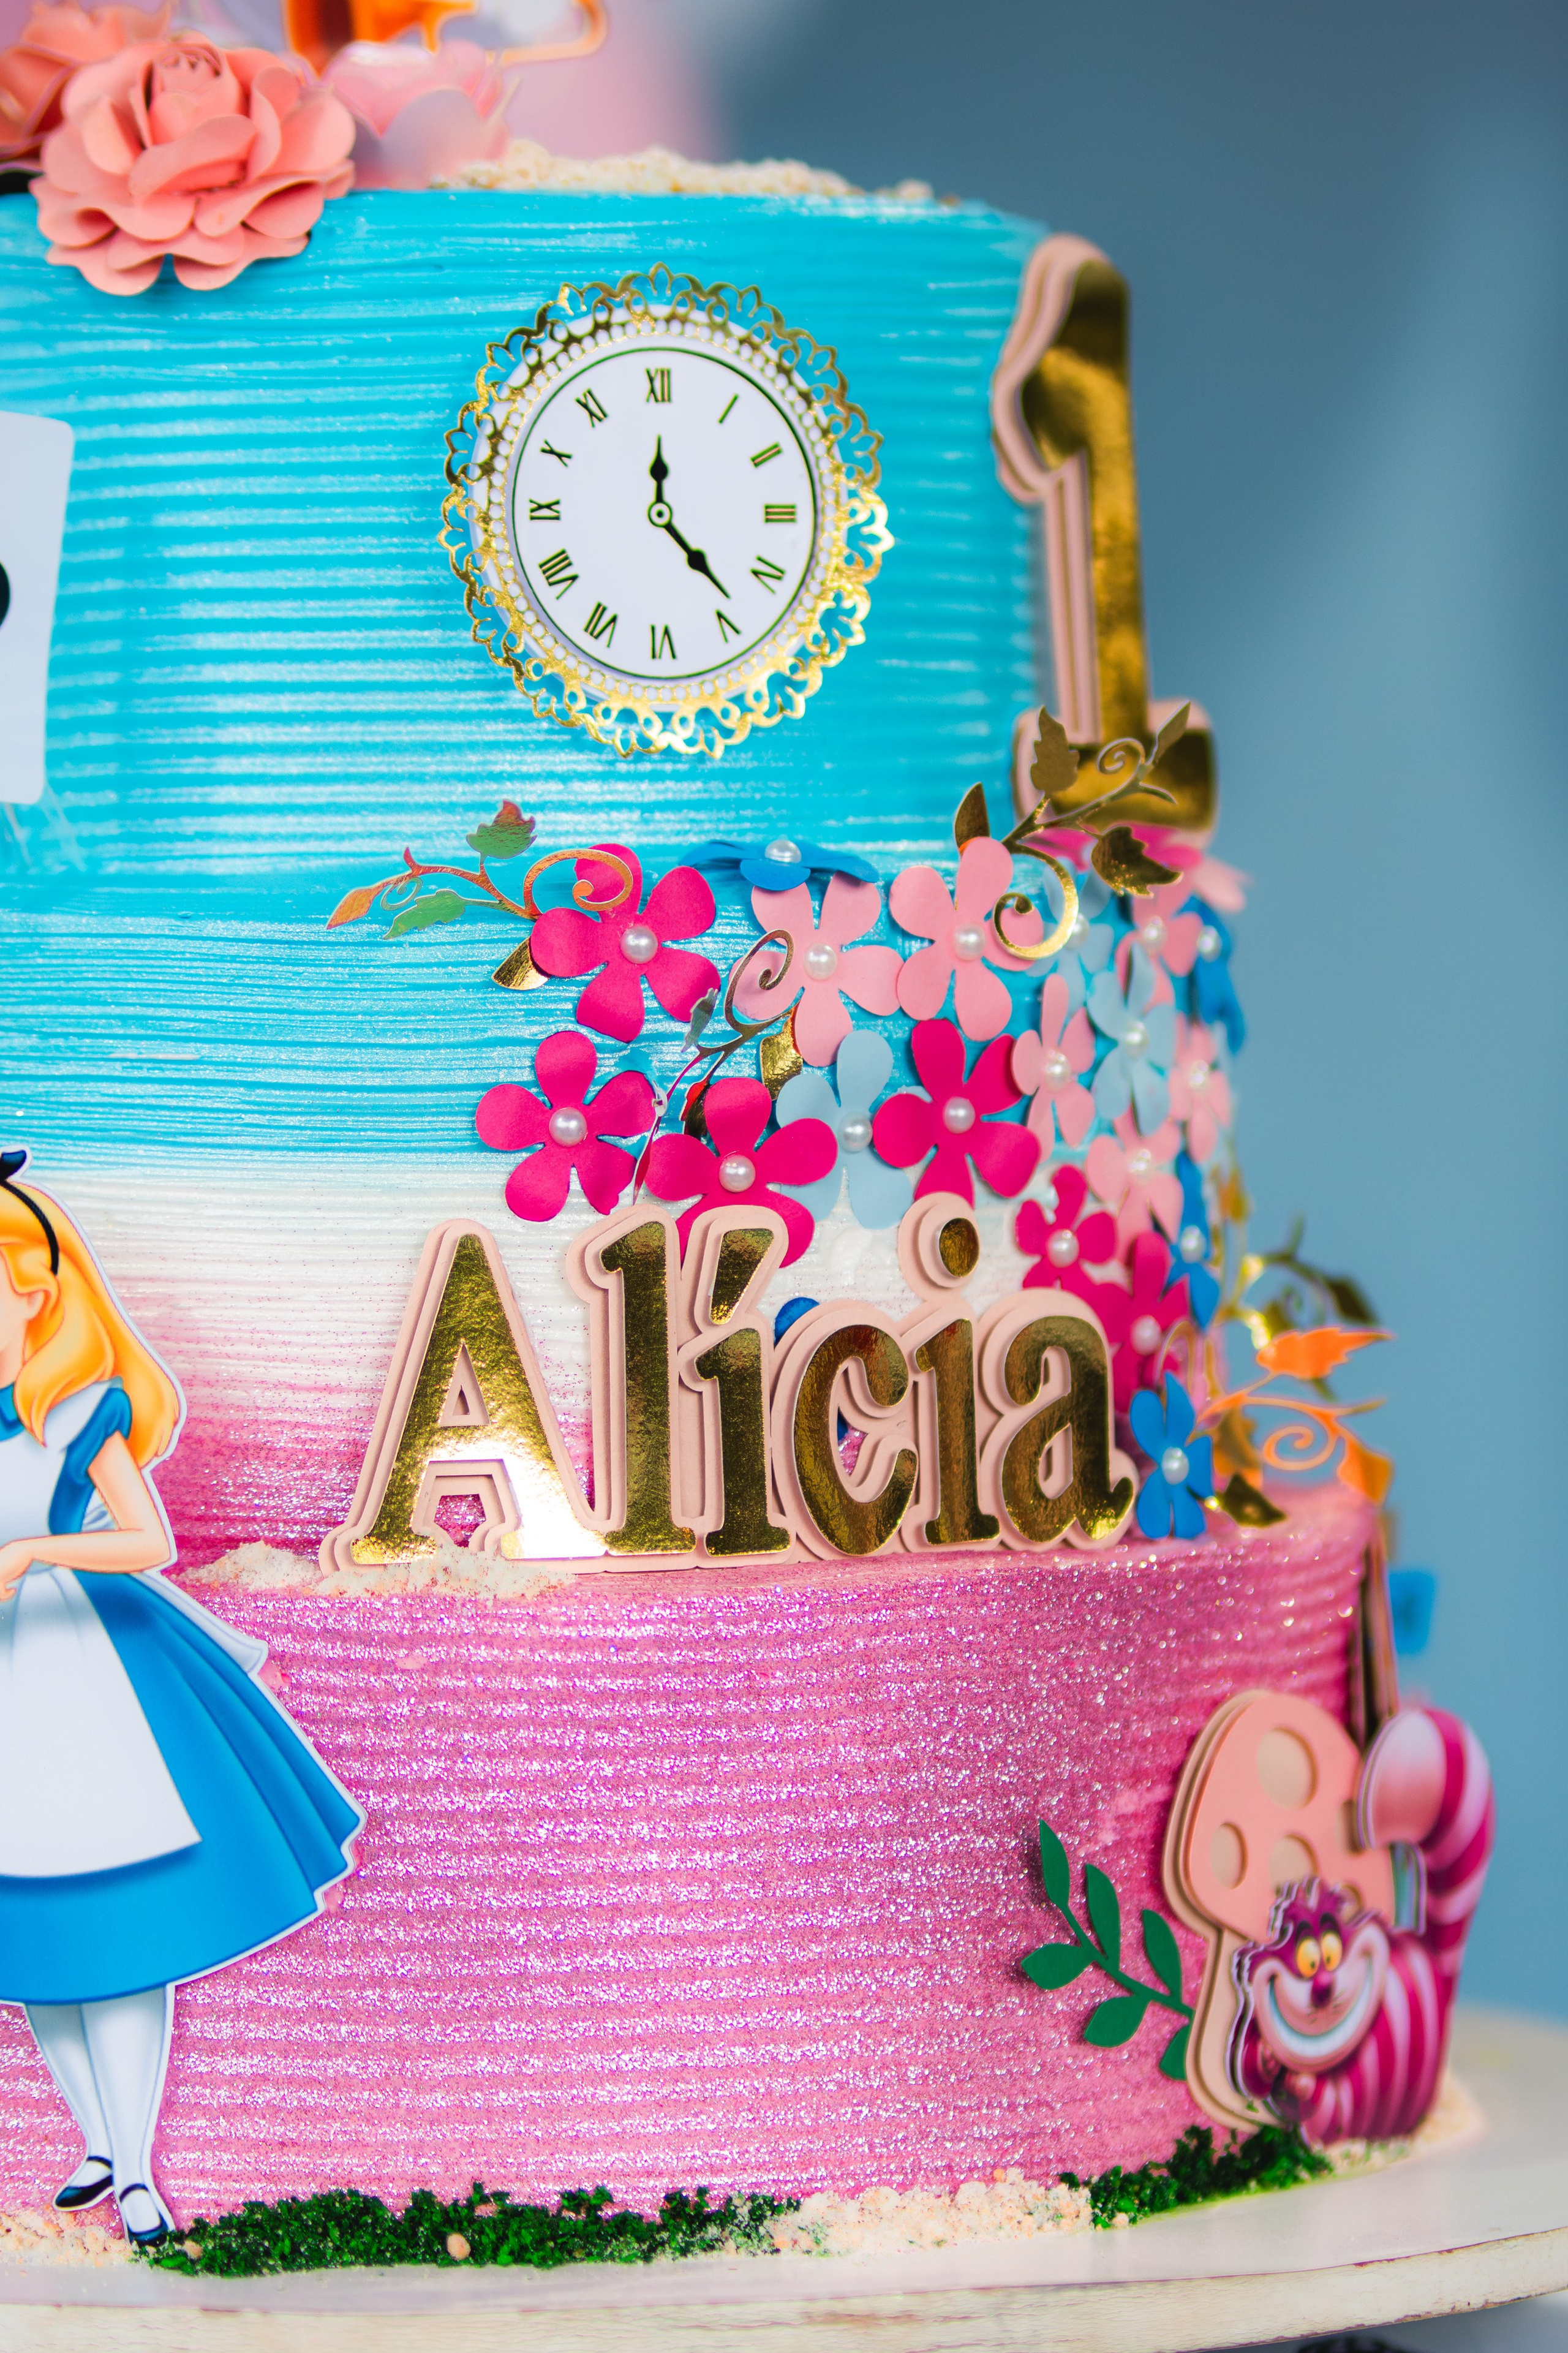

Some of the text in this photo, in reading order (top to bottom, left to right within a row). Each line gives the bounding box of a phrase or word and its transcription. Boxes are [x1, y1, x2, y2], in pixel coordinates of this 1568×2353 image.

[646, 369, 671, 403] XII
[576, 389, 608, 428] XI
[719, 395, 738, 423] I
[540, 440, 572, 467] X
[751, 444, 782, 467] II
[529, 499, 560, 521] IX
[764, 505, 796, 523] III
[537, 548, 579, 600] VIII
[751, 556, 785, 593] IV
[582, 600, 619, 648] VII
[716, 610, 741, 643] V
[651, 625, 677, 659] VI
[351, 1217, 1134, 1564] Alícia
